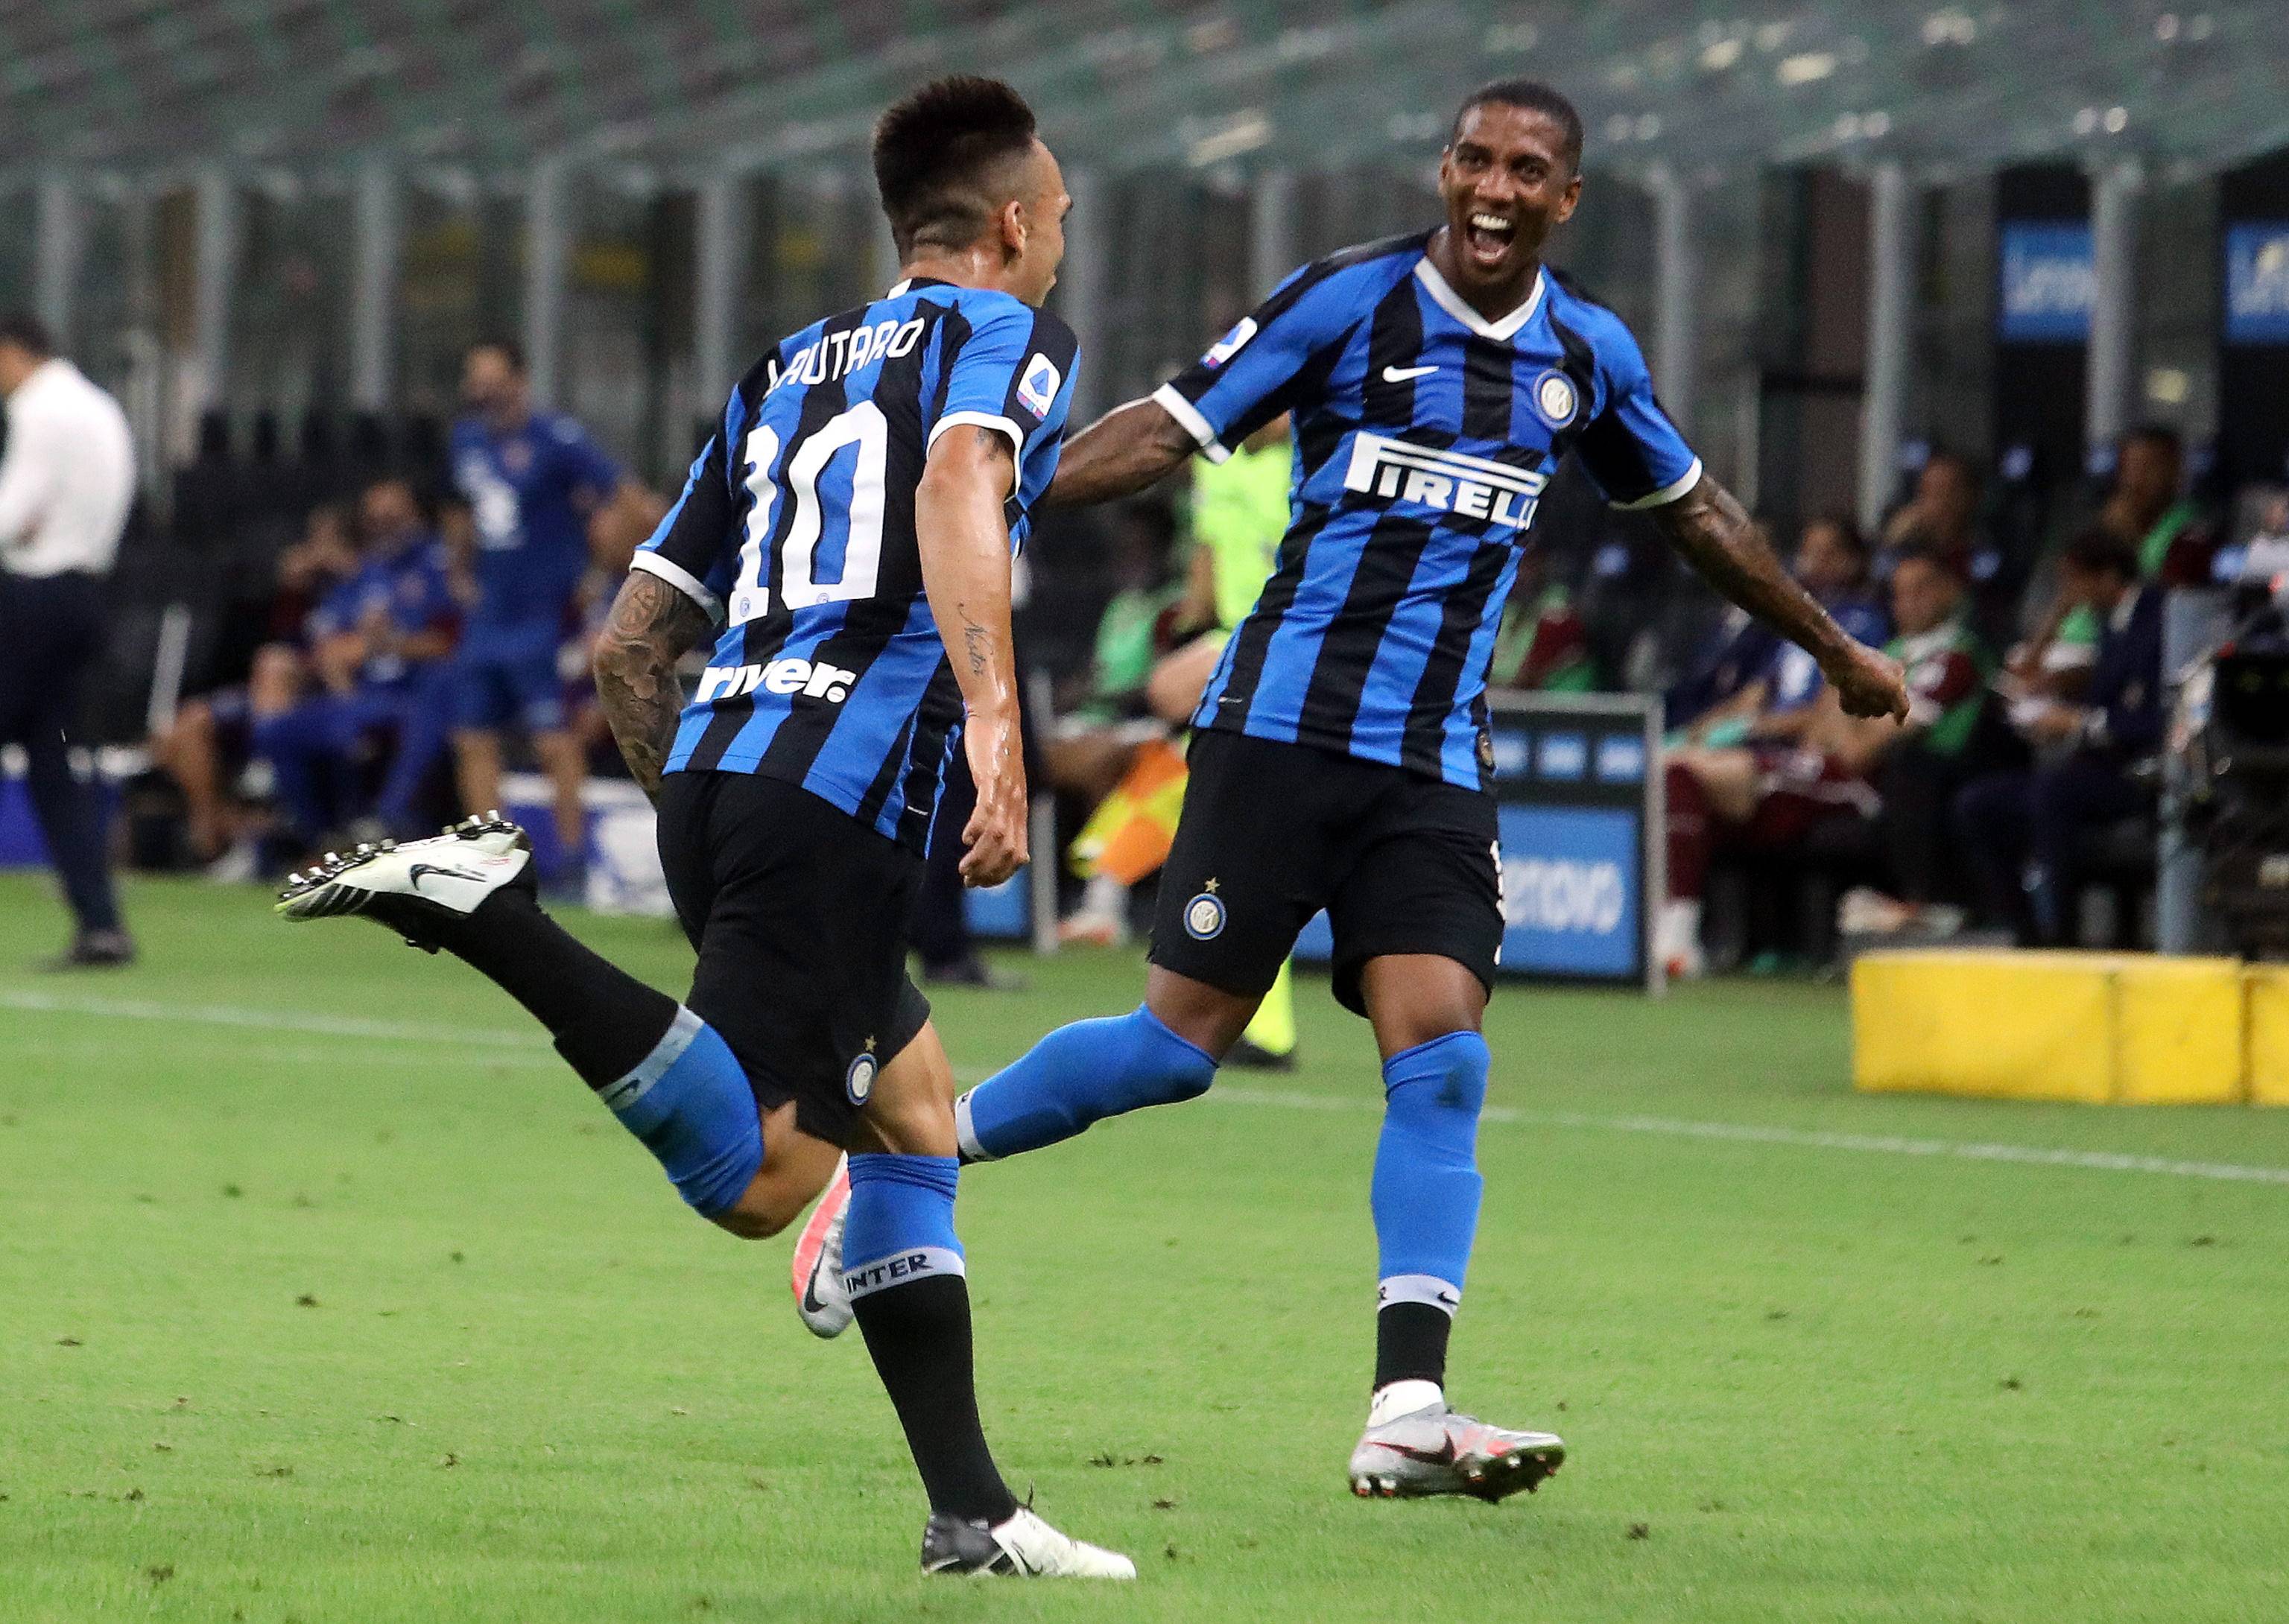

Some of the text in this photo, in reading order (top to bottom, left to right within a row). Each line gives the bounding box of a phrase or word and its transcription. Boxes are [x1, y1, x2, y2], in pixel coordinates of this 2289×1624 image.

[762, 317, 925, 400] LAUTARO
[729, 399, 888, 628] 10
[846, 1253, 934, 1295] INTER
